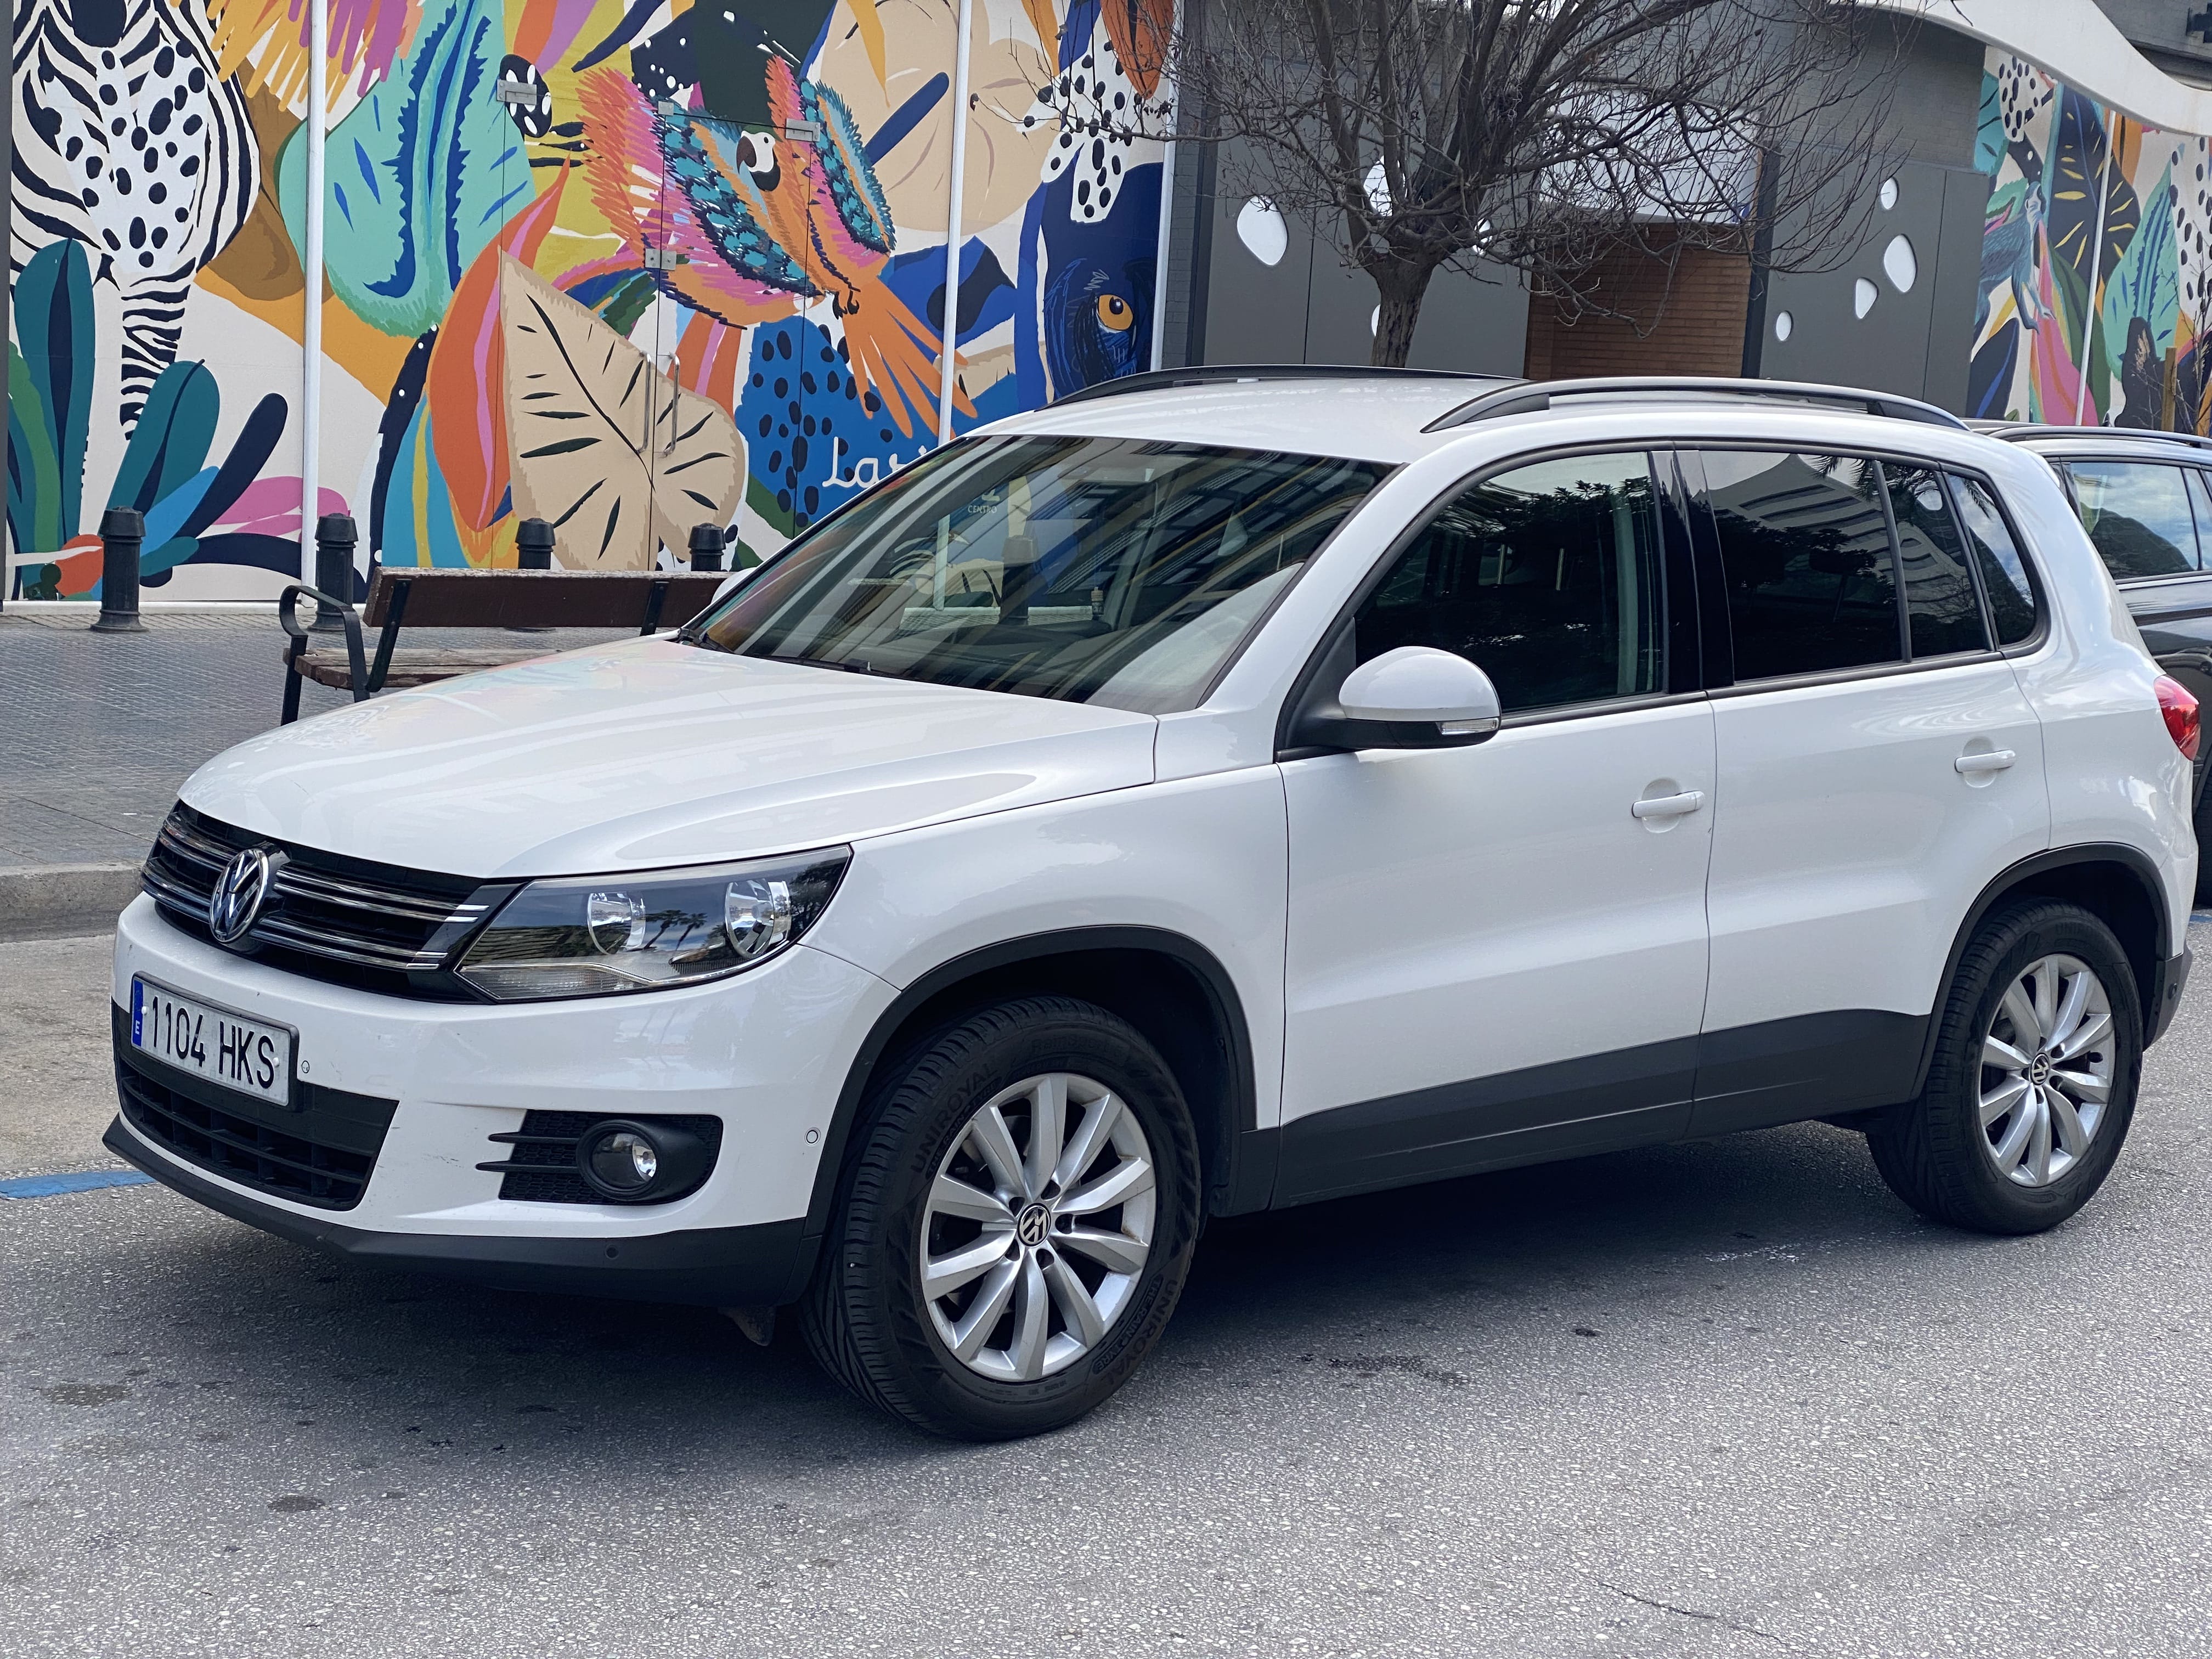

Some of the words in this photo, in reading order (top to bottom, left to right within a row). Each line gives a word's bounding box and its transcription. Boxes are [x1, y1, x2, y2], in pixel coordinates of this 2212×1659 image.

[135, 1019, 140, 1035] E
[153, 996, 206, 1068] 1104
[218, 1020, 275, 1089] HKS
[910, 1063, 998, 1174] UNIROYAL
[1125, 1308, 1150, 1339] RAIN
[1146, 1280, 1162, 1306] THE
[1096, 1343, 1124, 1369] TYRE
[1101, 1278, 1178, 1385] UNIROYAL
